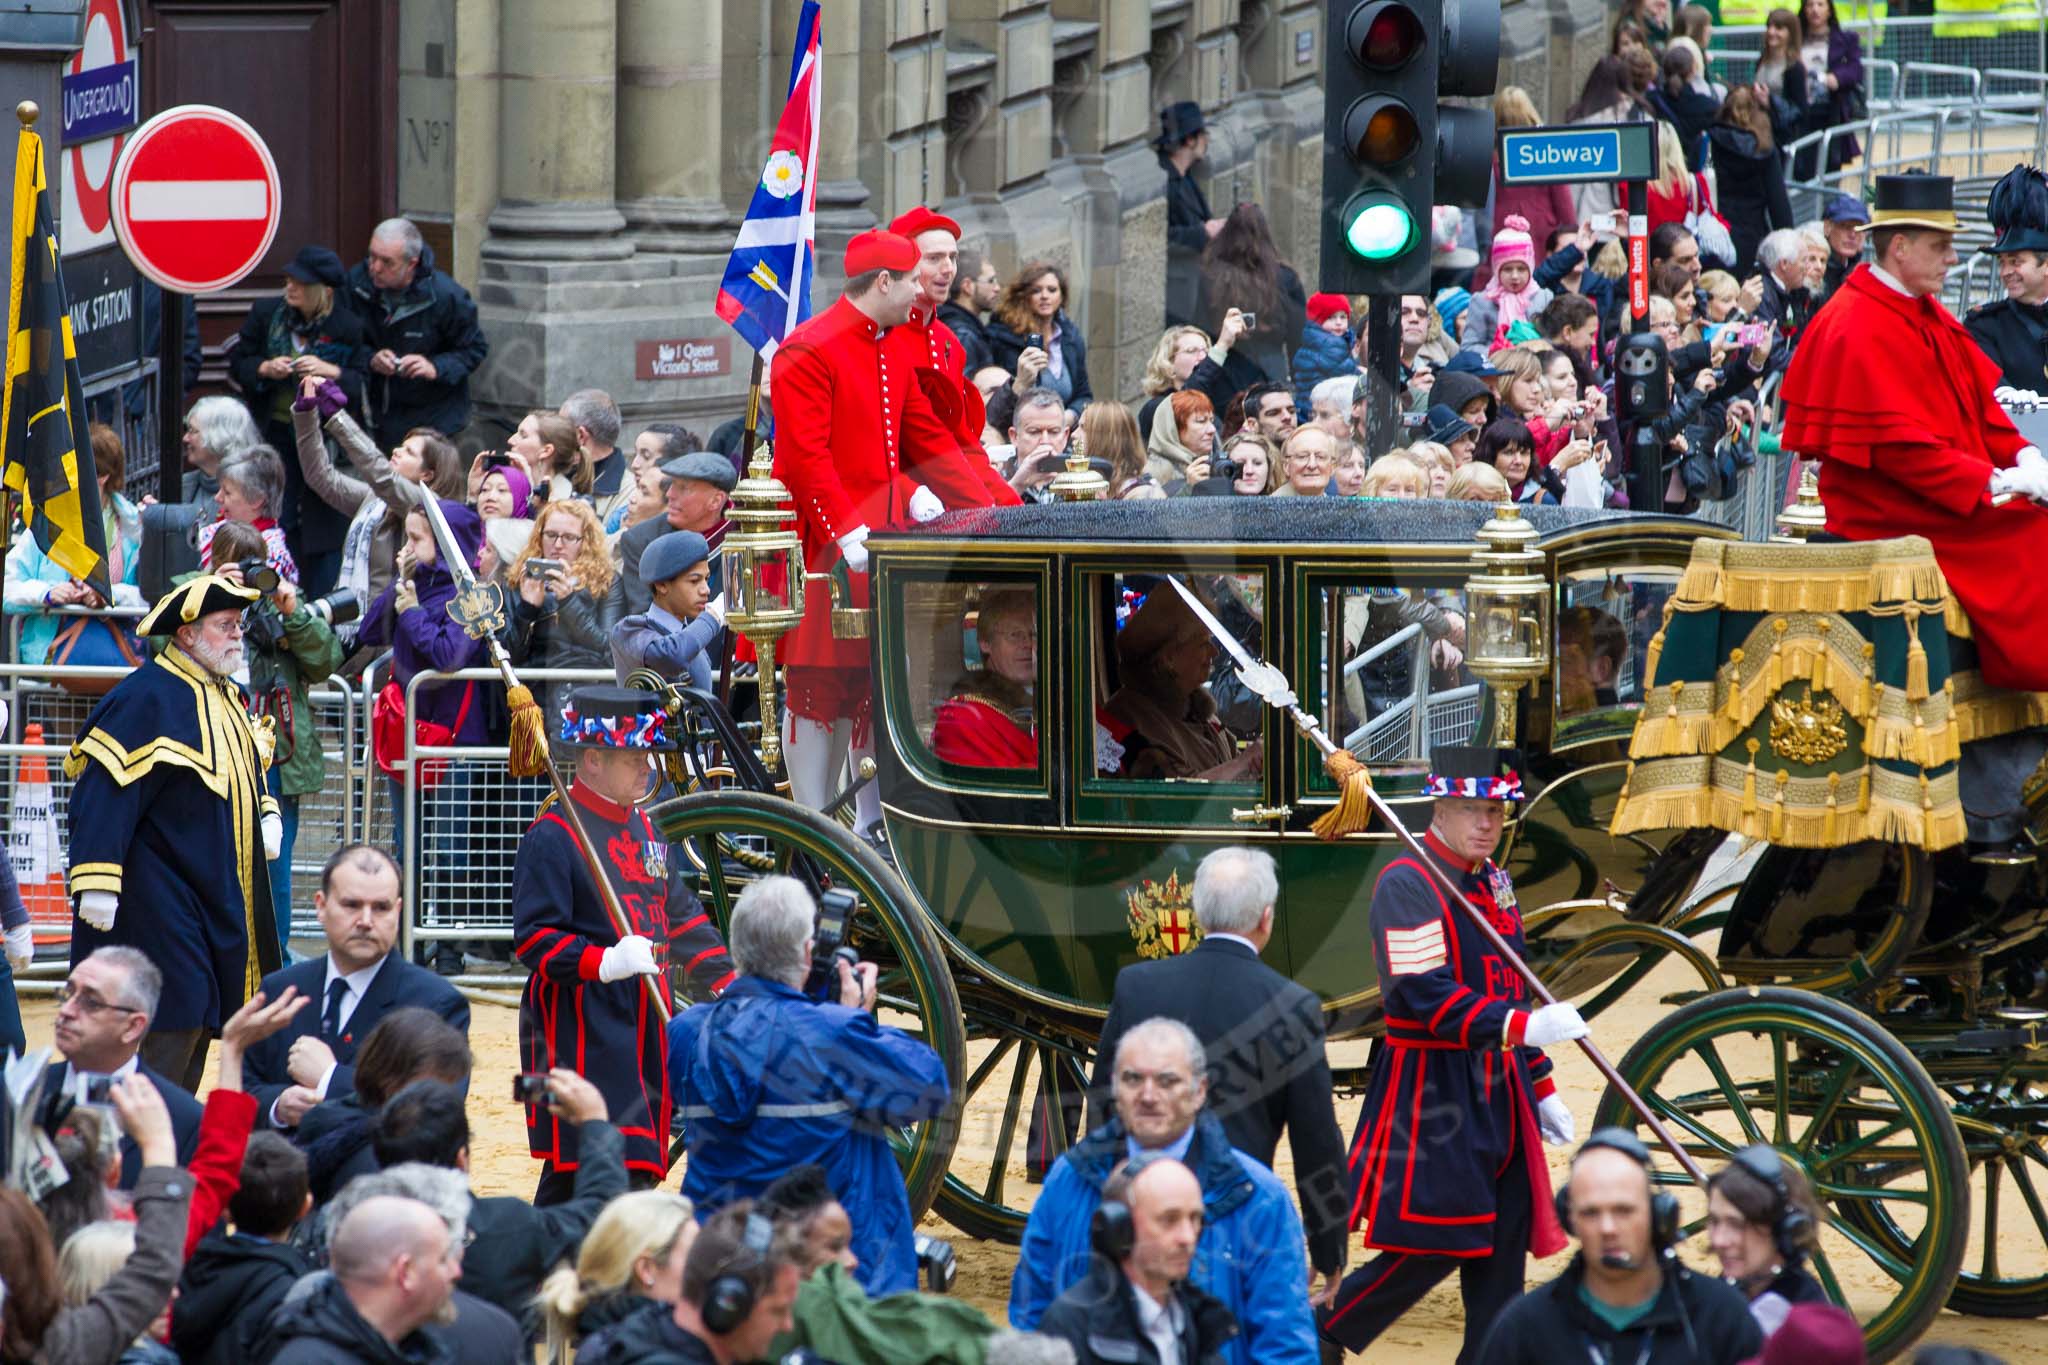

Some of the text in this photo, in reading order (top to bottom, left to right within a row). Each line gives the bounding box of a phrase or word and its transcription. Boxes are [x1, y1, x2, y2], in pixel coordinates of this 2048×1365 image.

[64, 75, 132, 130] UNDERGROUND
[1519, 144, 1604, 165] Subway
[1632, 240, 1645, 309] gum butts
[92, 286, 132, 330] STATION
[651, 358, 720, 376] Victoria Street
[683, 343, 715, 359] Queen
